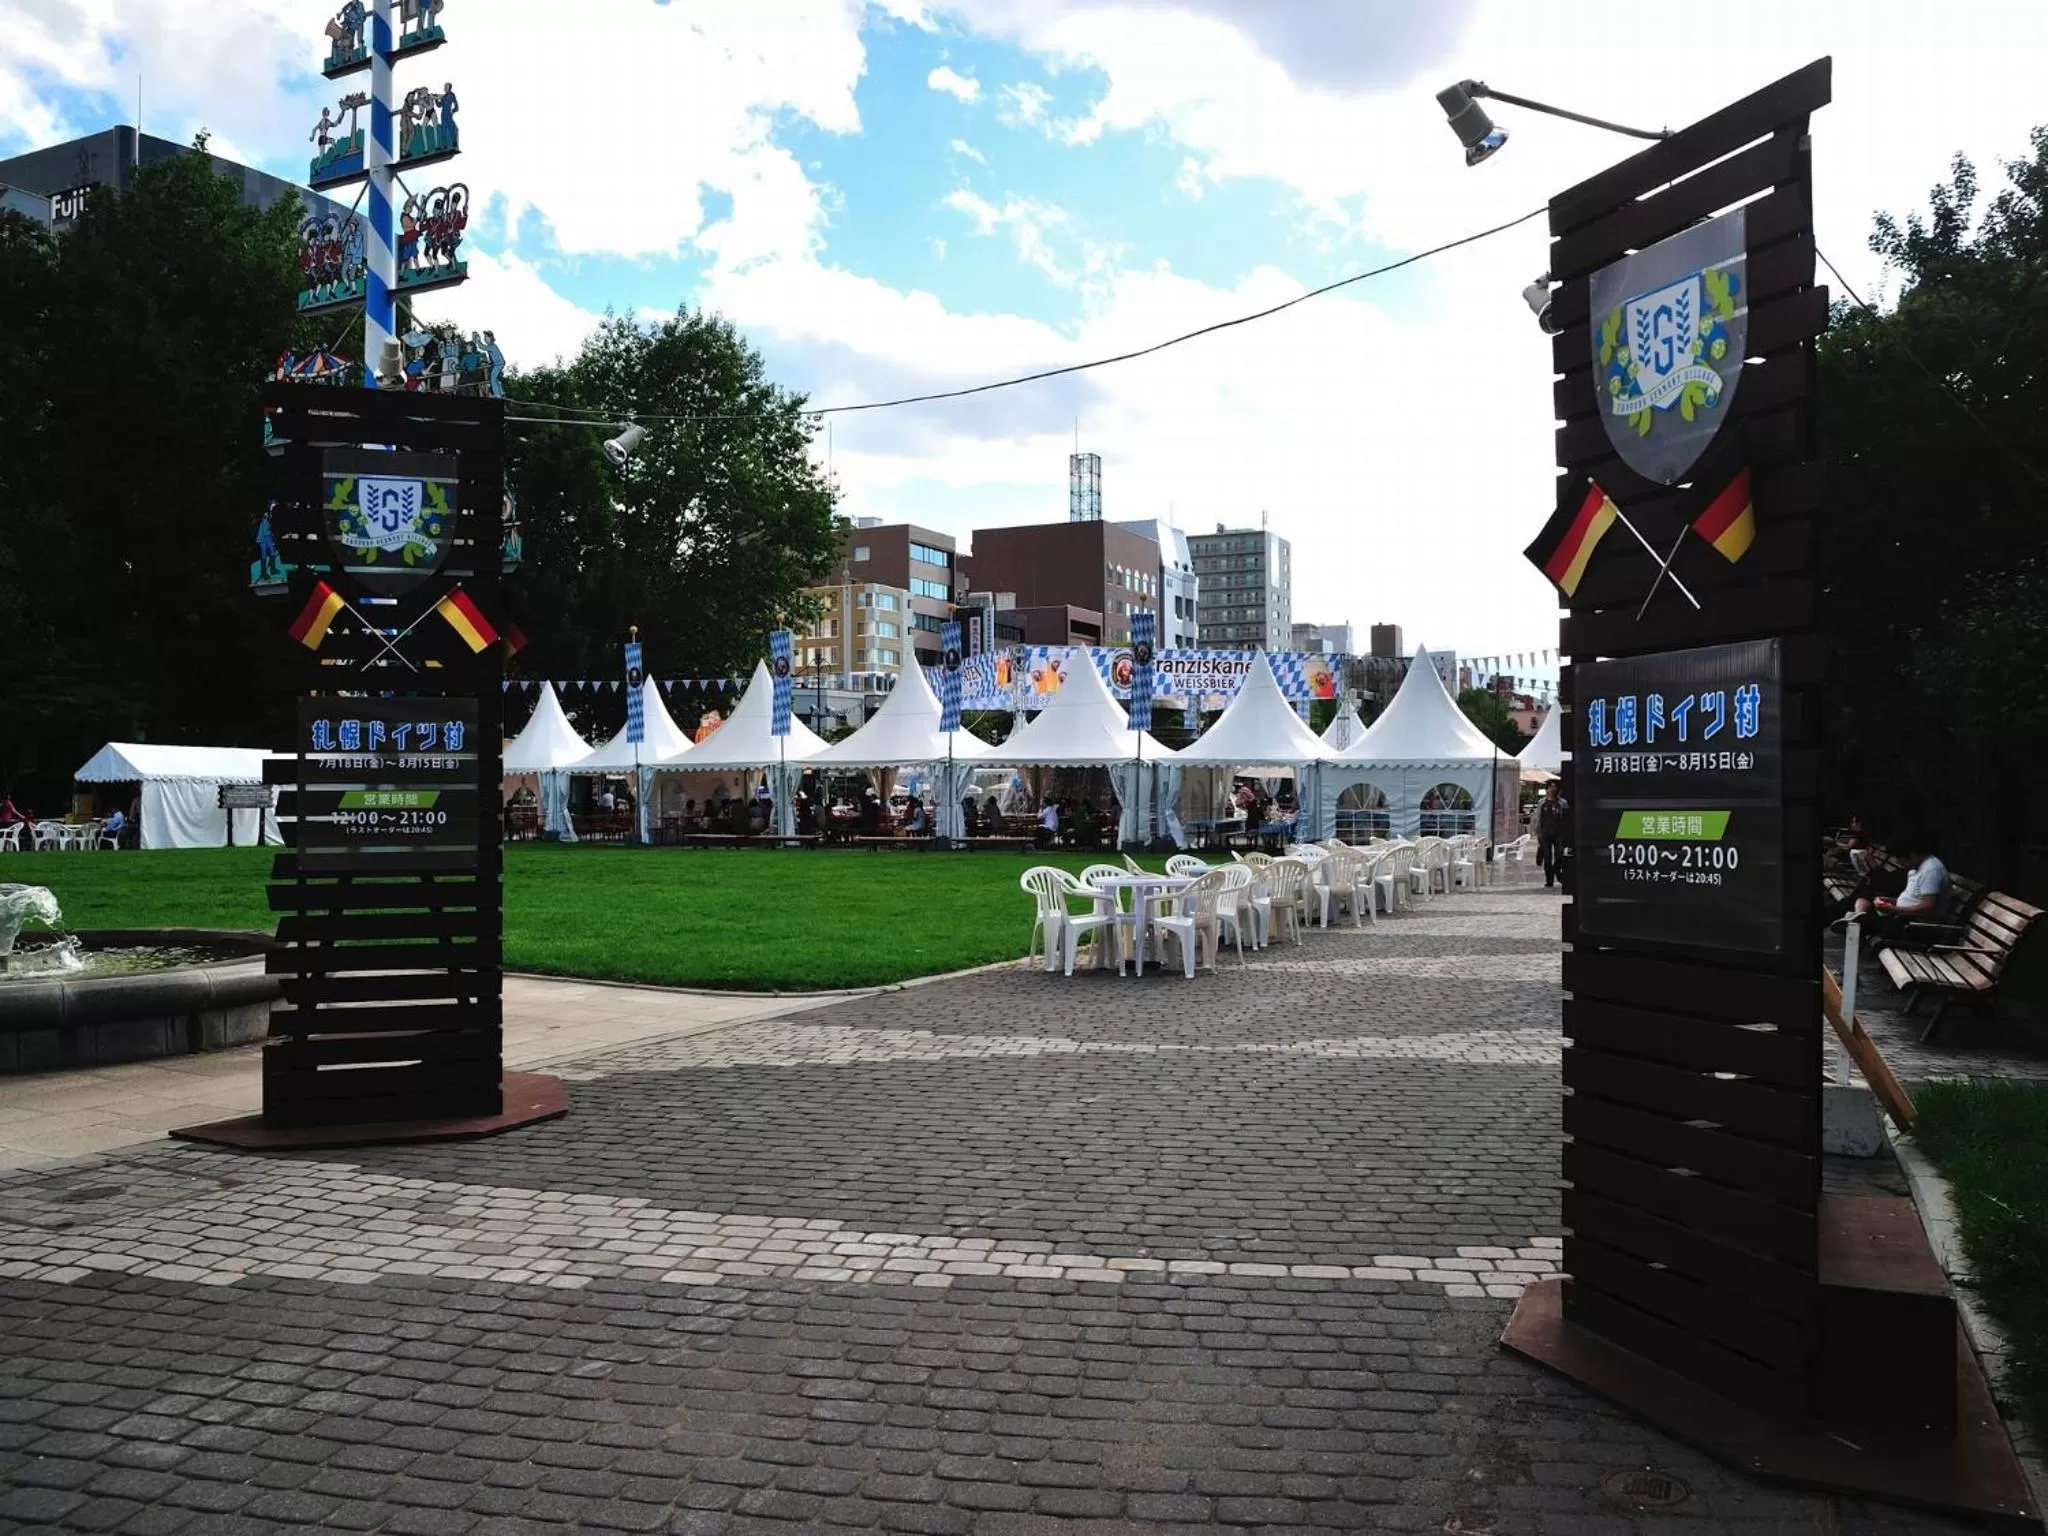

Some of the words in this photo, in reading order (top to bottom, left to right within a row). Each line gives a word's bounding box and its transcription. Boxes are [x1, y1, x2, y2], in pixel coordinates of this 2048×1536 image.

[52, 187, 91, 220] Fuji
[1152, 657, 1253, 675] ranziskane
[1173, 677, 1236, 689] WEISSBIER
[1588, 683, 1761, 747] 札幌ドイツ村
[311, 719, 465, 751] 札幌ドイツ村
[363, 793, 419, 806] 営業時間
[1641, 815, 1703, 836] 営業時間
